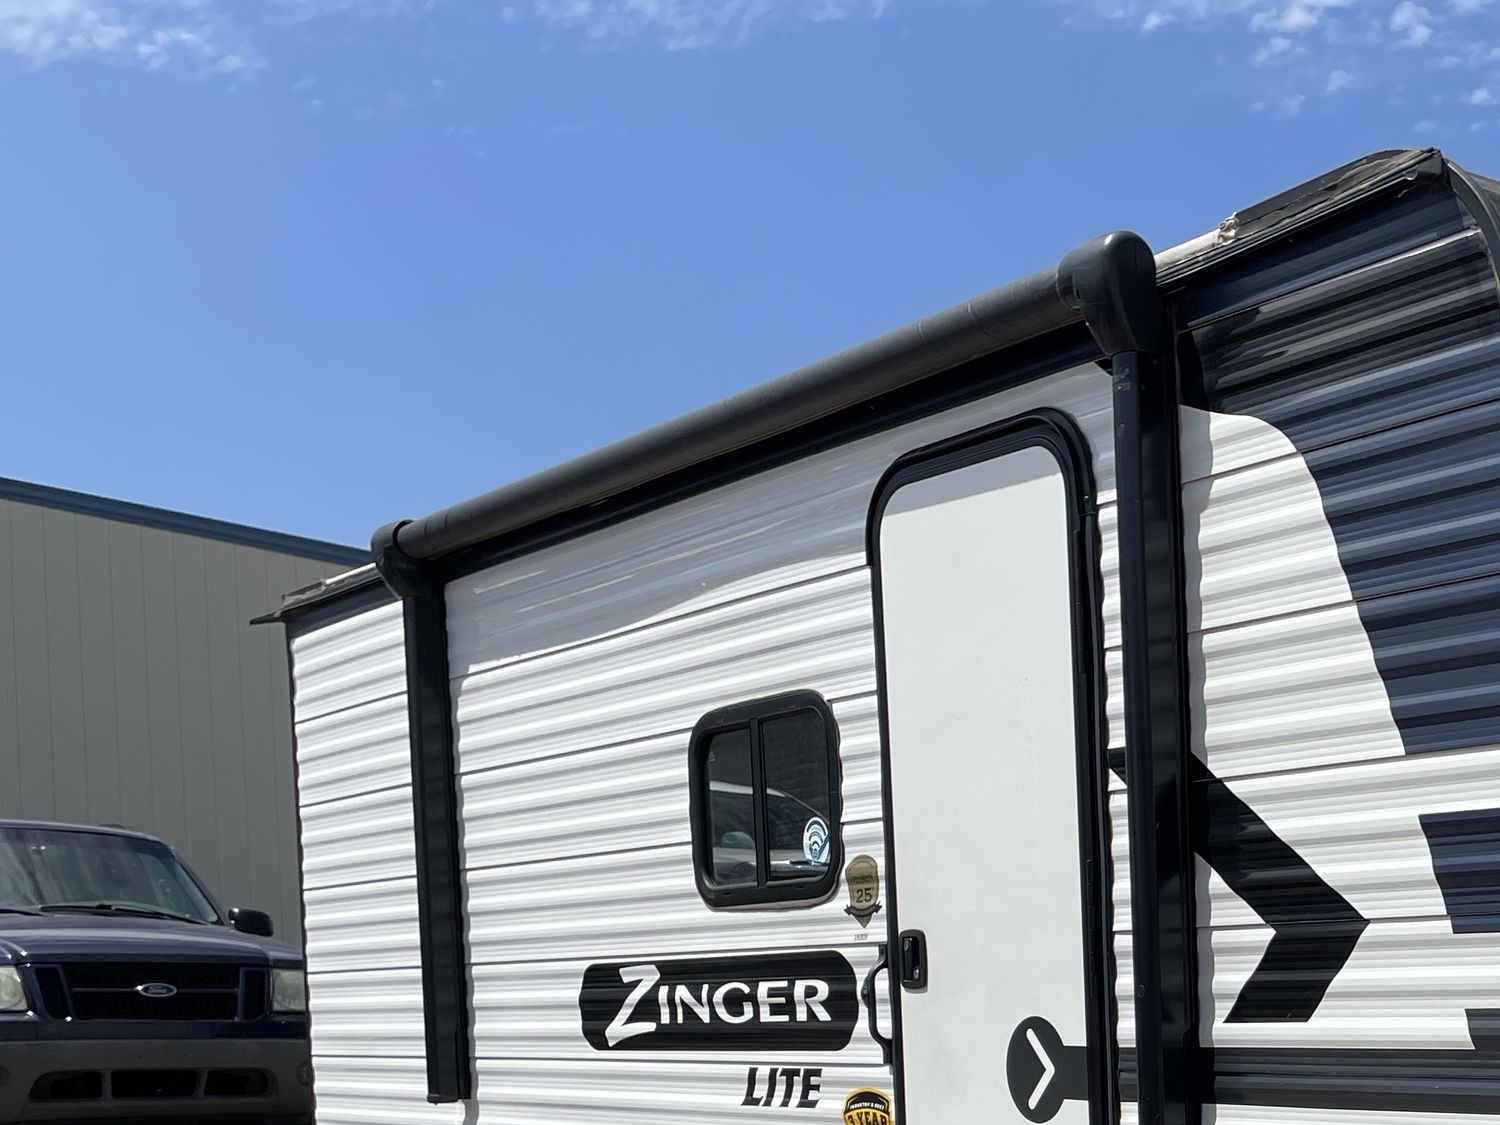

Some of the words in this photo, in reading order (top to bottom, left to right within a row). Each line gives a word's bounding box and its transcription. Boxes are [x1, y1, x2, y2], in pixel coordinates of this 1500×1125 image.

[856, 887, 873, 904] 25
[604, 964, 832, 1048] ZINGER
[741, 1067, 822, 1109] LITE
